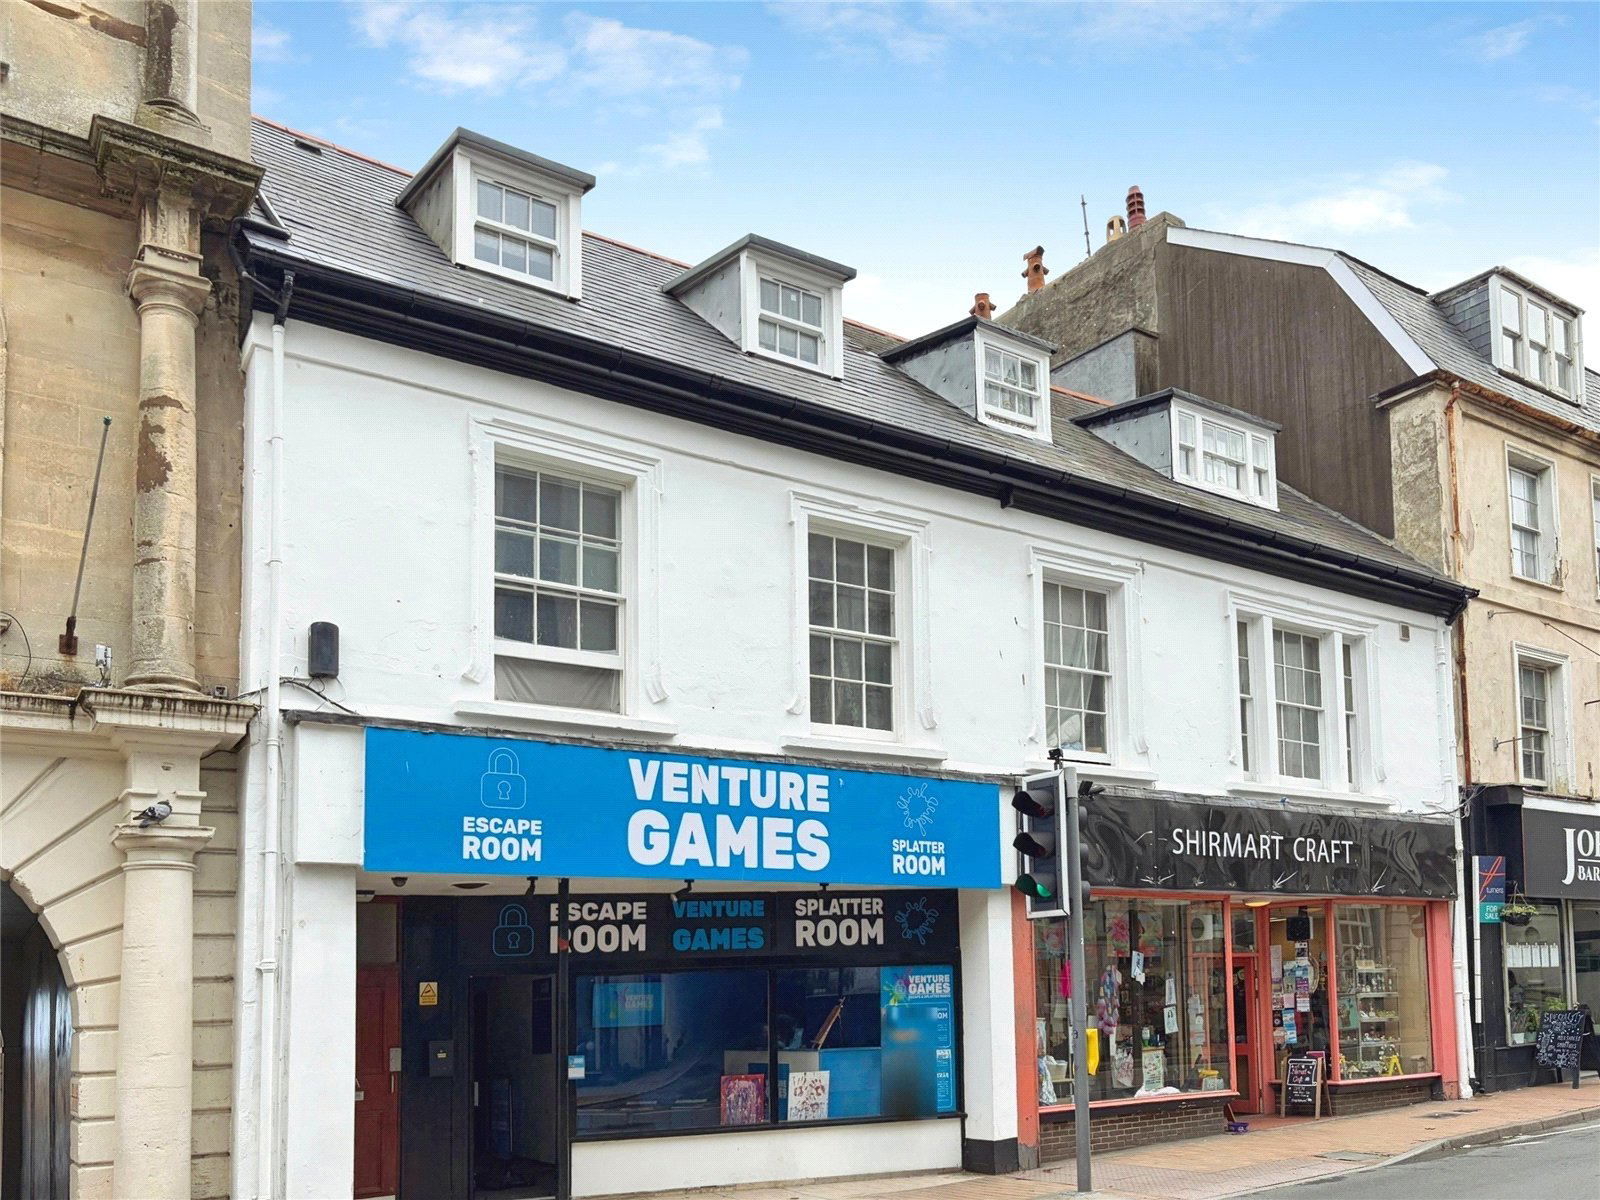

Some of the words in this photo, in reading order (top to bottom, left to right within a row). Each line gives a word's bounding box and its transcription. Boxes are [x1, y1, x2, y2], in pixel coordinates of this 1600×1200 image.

[628, 758, 830, 813] VENTURE
[463, 816, 542, 836] ESCAPE
[463, 835, 541, 862] ROOM
[628, 809, 831, 871] GAMES
[892, 839, 945, 854] SPLATTER
[1172, 828, 1284, 860] SHIRMART
[1293, 837, 1353, 864] CRAFT
[892, 854, 946, 876] ROOM
[672, 900, 765, 918] VENTURE
[795, 898, 884, 916] SPLATTER
[1484, 912, 1500, 920] SALE
[1486, 905, 1498, 913] FOR
[672, 927, 764, 951] GAMES
[795, 918, 884, 947] ROOM
[908, 974, 950, 983] VENTURE
[908, 982, 951, 994] GAMES
